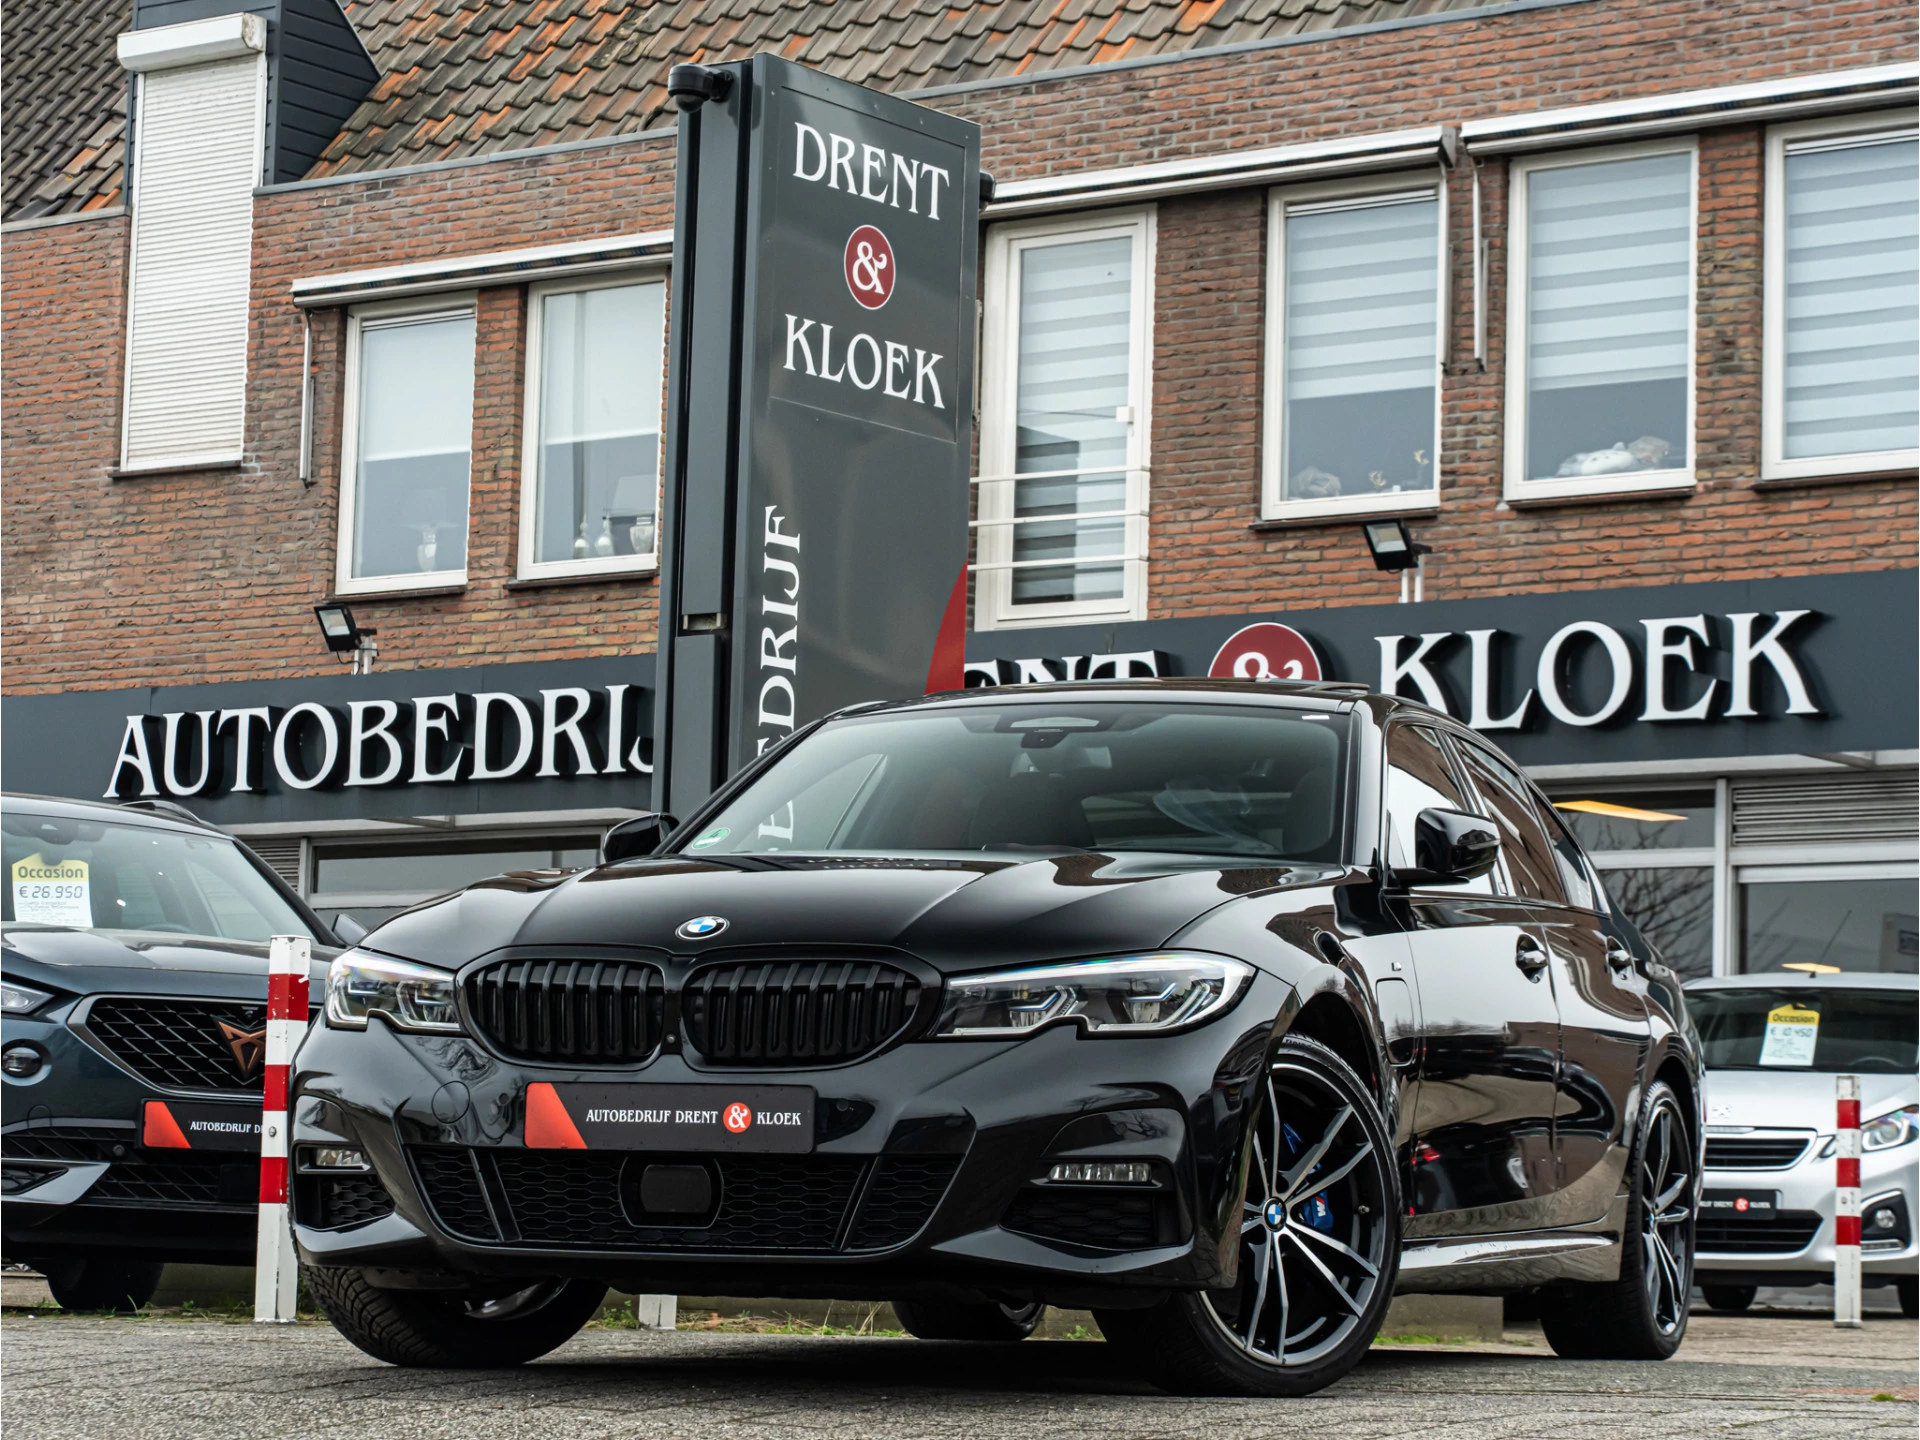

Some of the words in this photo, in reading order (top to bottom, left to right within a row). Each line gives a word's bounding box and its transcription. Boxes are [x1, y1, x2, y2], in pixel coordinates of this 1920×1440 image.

[793, 122, 950, 221] DRENT
[852, 241, 887, 295] &
[783, 313, 946, 410] KLOEK
[1374, 609, 1820, 729] KLOEK
[18, 866, 84, 879] Occasion
[19, 886, 29, 898] €
[31, 886, 83, 899] 26.950
[1772, 1013, 1816, 1024] Occasion
[190, 1121, 252, 1134] AUTOBEDRIJF
[586, 1109, 671, 1124] AUTOBEDRIJF
[675, 1110, 718, 1125] DRENT
[728, 1105, 749, 1129] &
[757, 1111, 801, 1126] KLOEK
